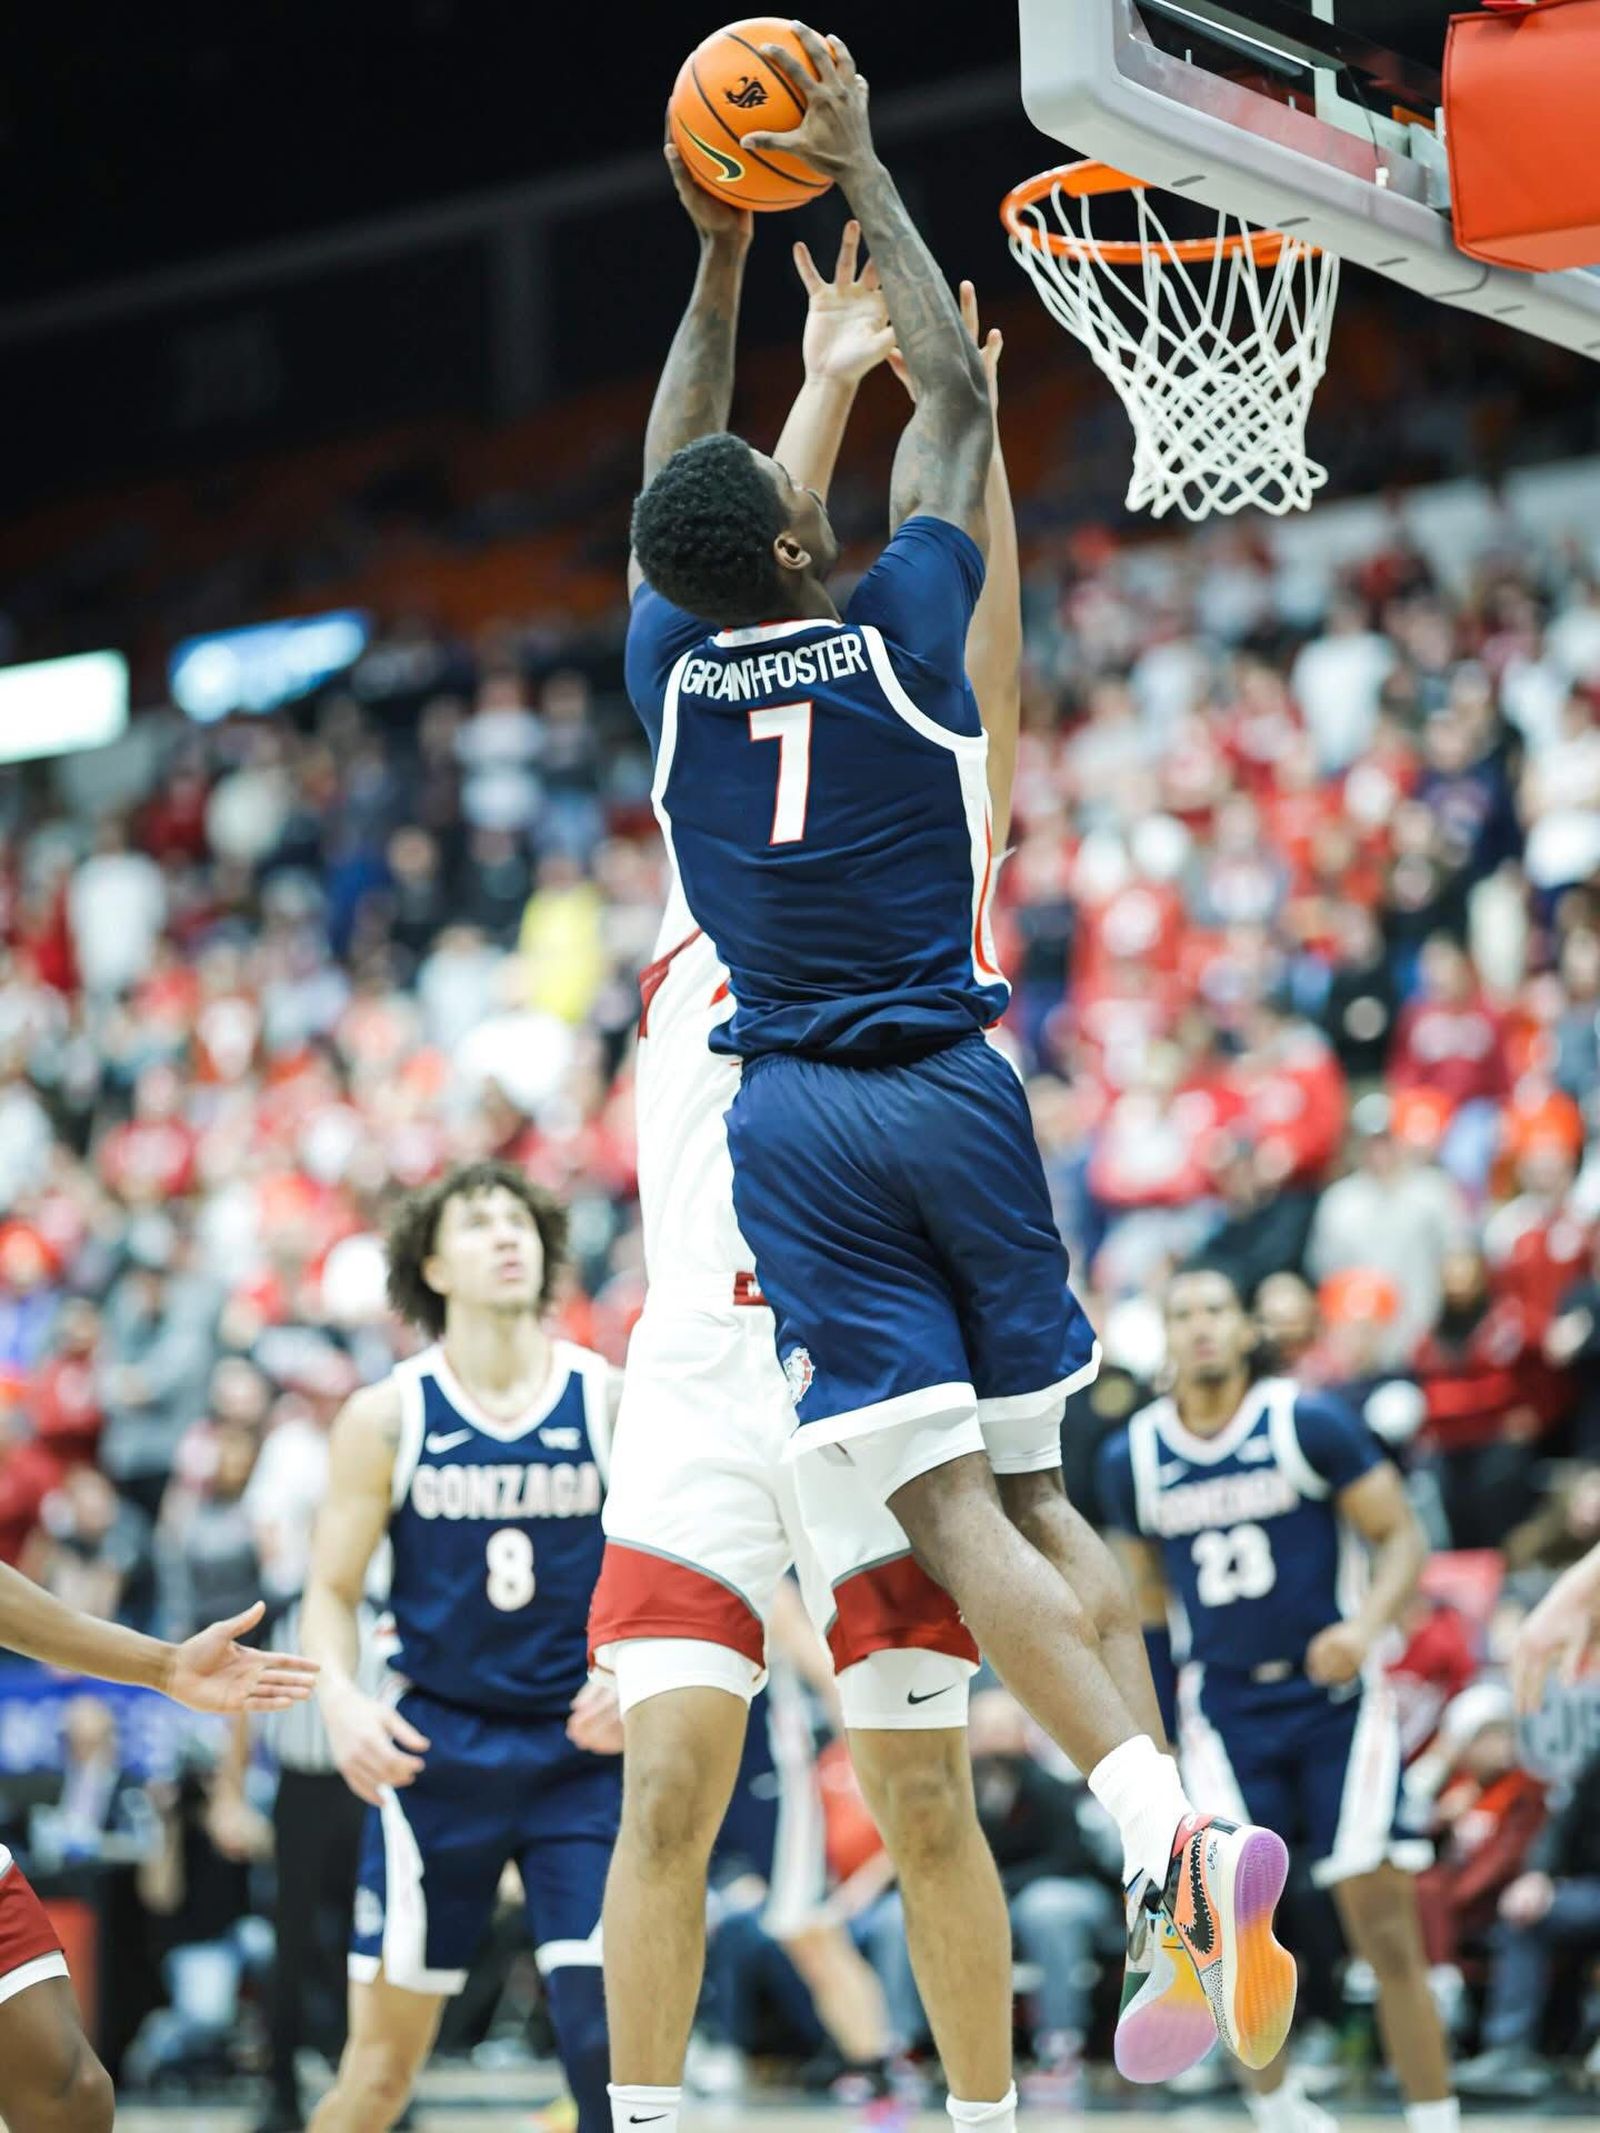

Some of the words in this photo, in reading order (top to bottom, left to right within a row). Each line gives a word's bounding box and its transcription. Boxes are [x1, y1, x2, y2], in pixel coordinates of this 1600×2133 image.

[748, 699, 814, 846] 7
[412, 1462, 600, 1520] GONZAGA
[486, 1527, 535, 1612] 8
[1191, 1522, 1276, 1607] 23
